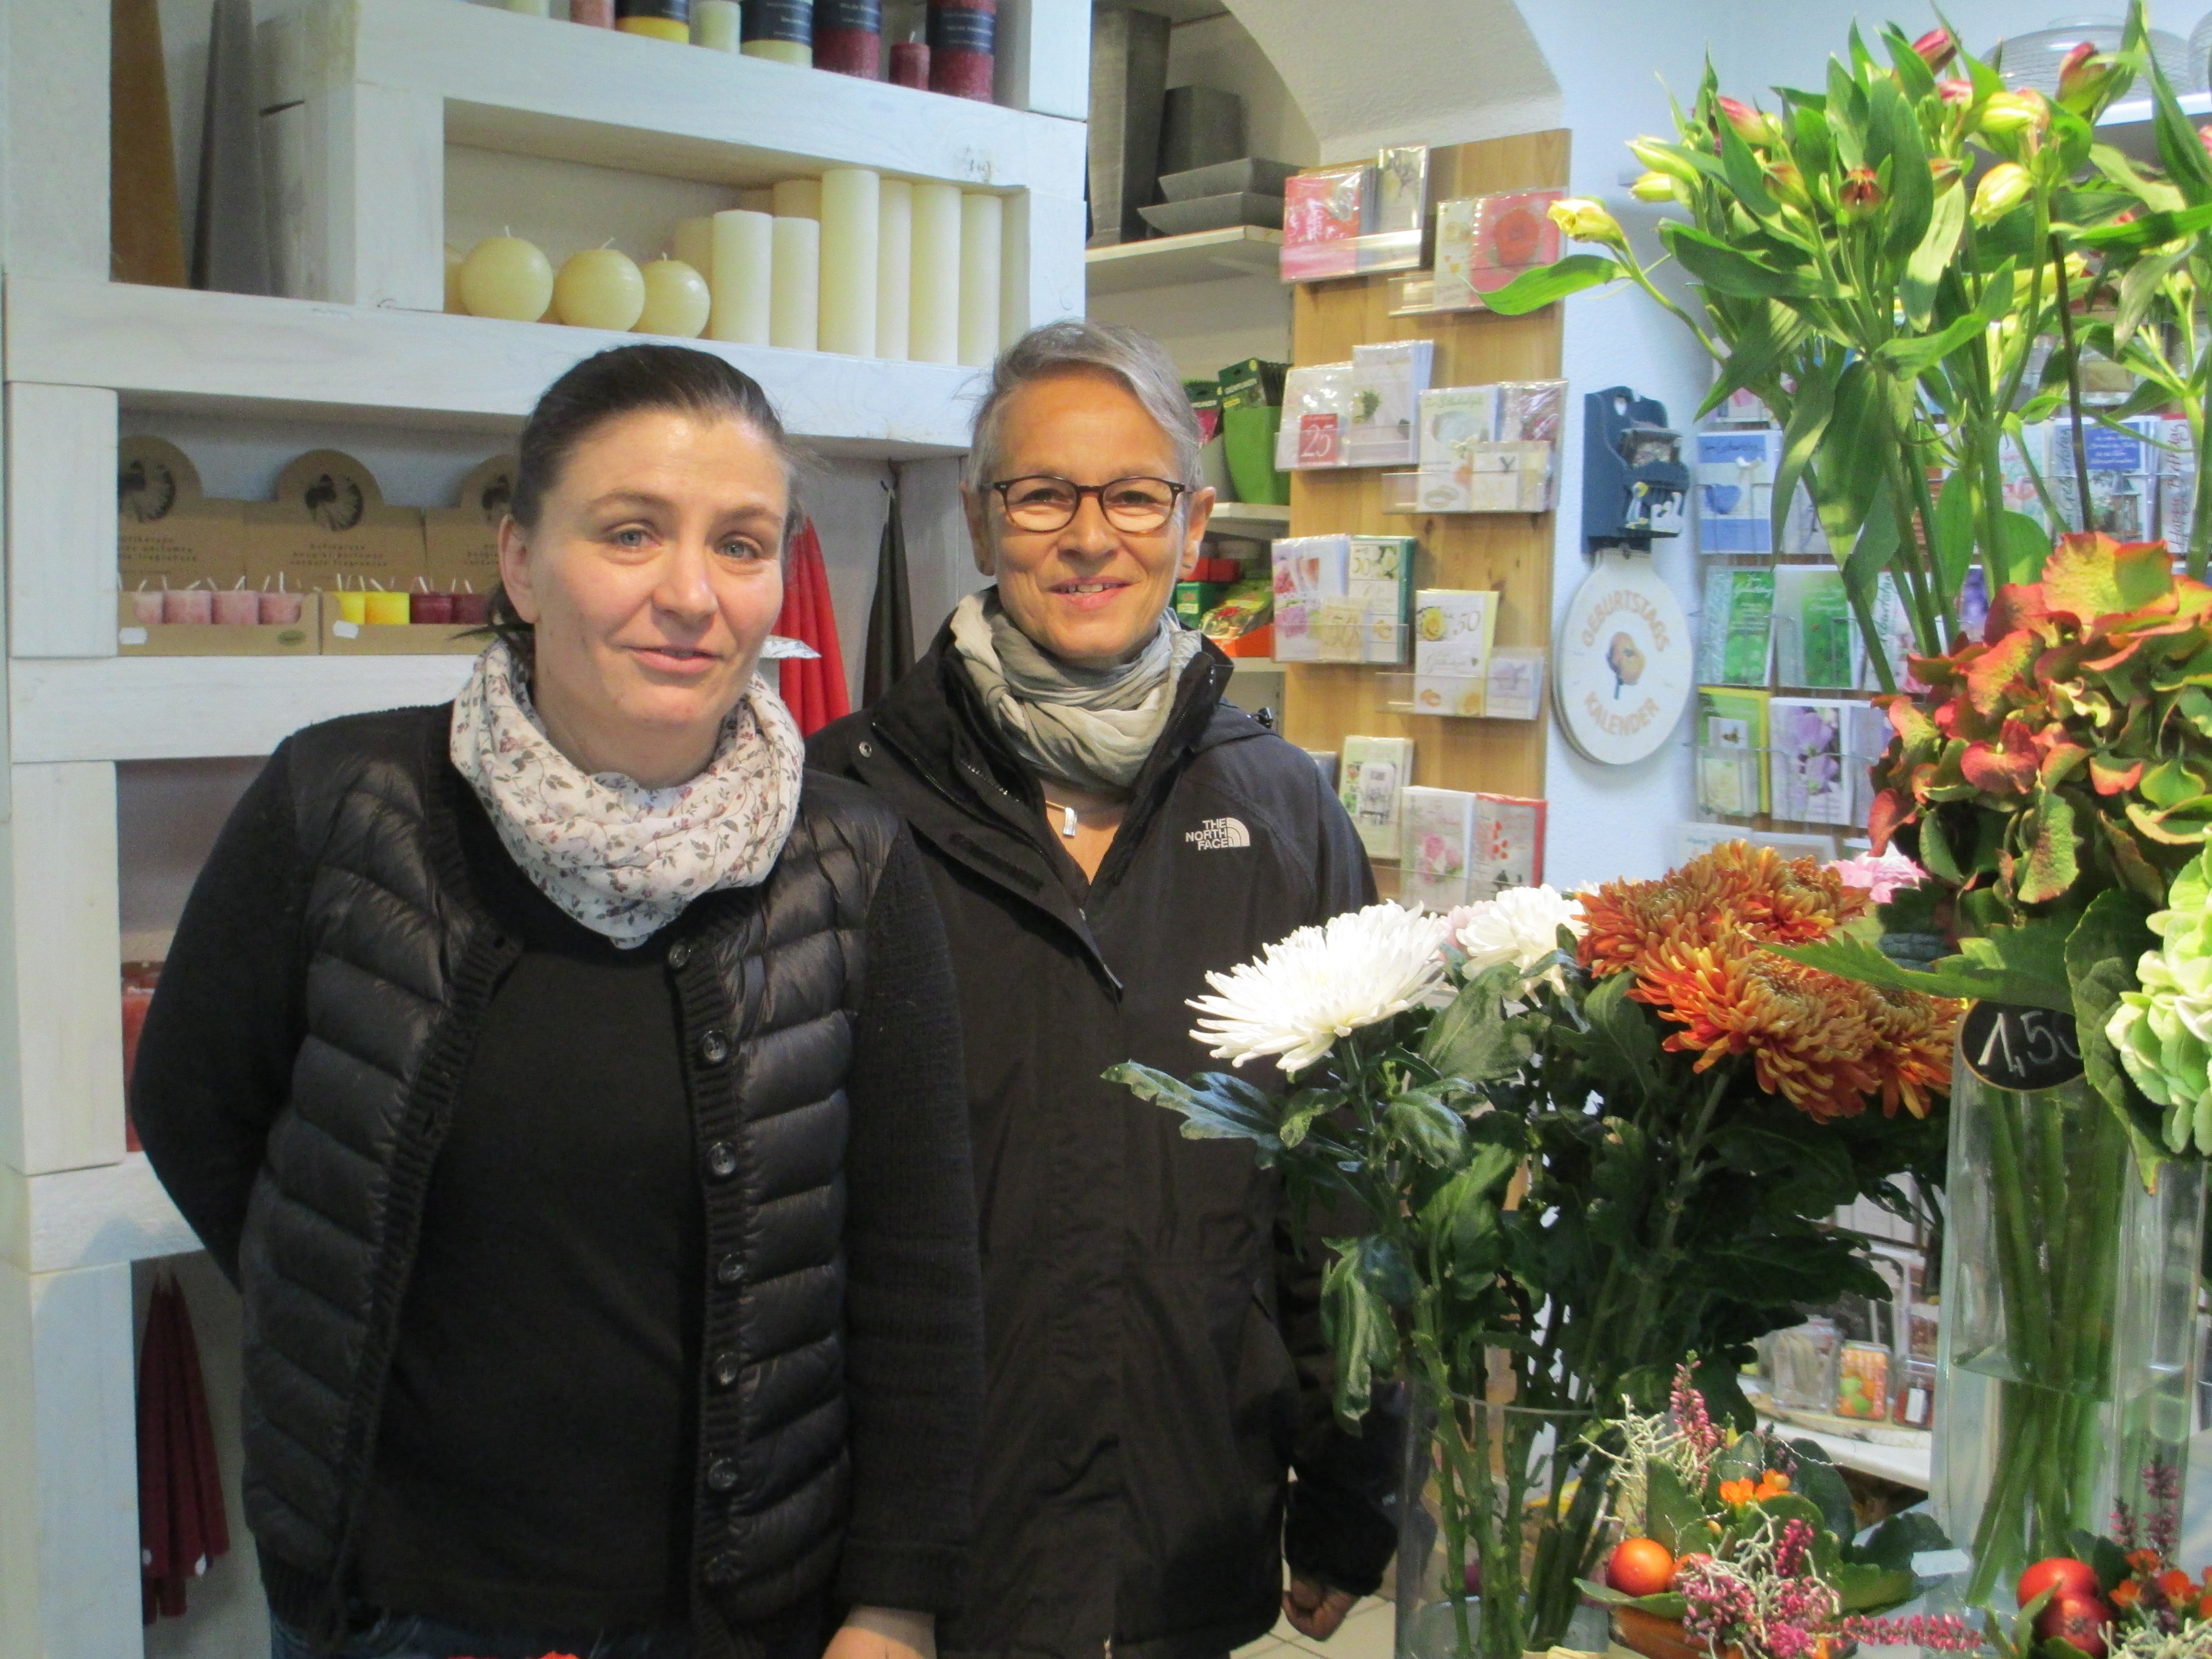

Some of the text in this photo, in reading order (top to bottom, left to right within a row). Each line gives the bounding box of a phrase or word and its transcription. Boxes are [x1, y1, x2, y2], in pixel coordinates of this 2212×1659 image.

[1300, 424, 1335, 457] 25
[1584, 690, 1659, 736] KALENDER
[1202, 818, 1226, 830] THE
[1185, 828, 1227, 842] NORTH
[1197, 838, 1228, 851] FACE
